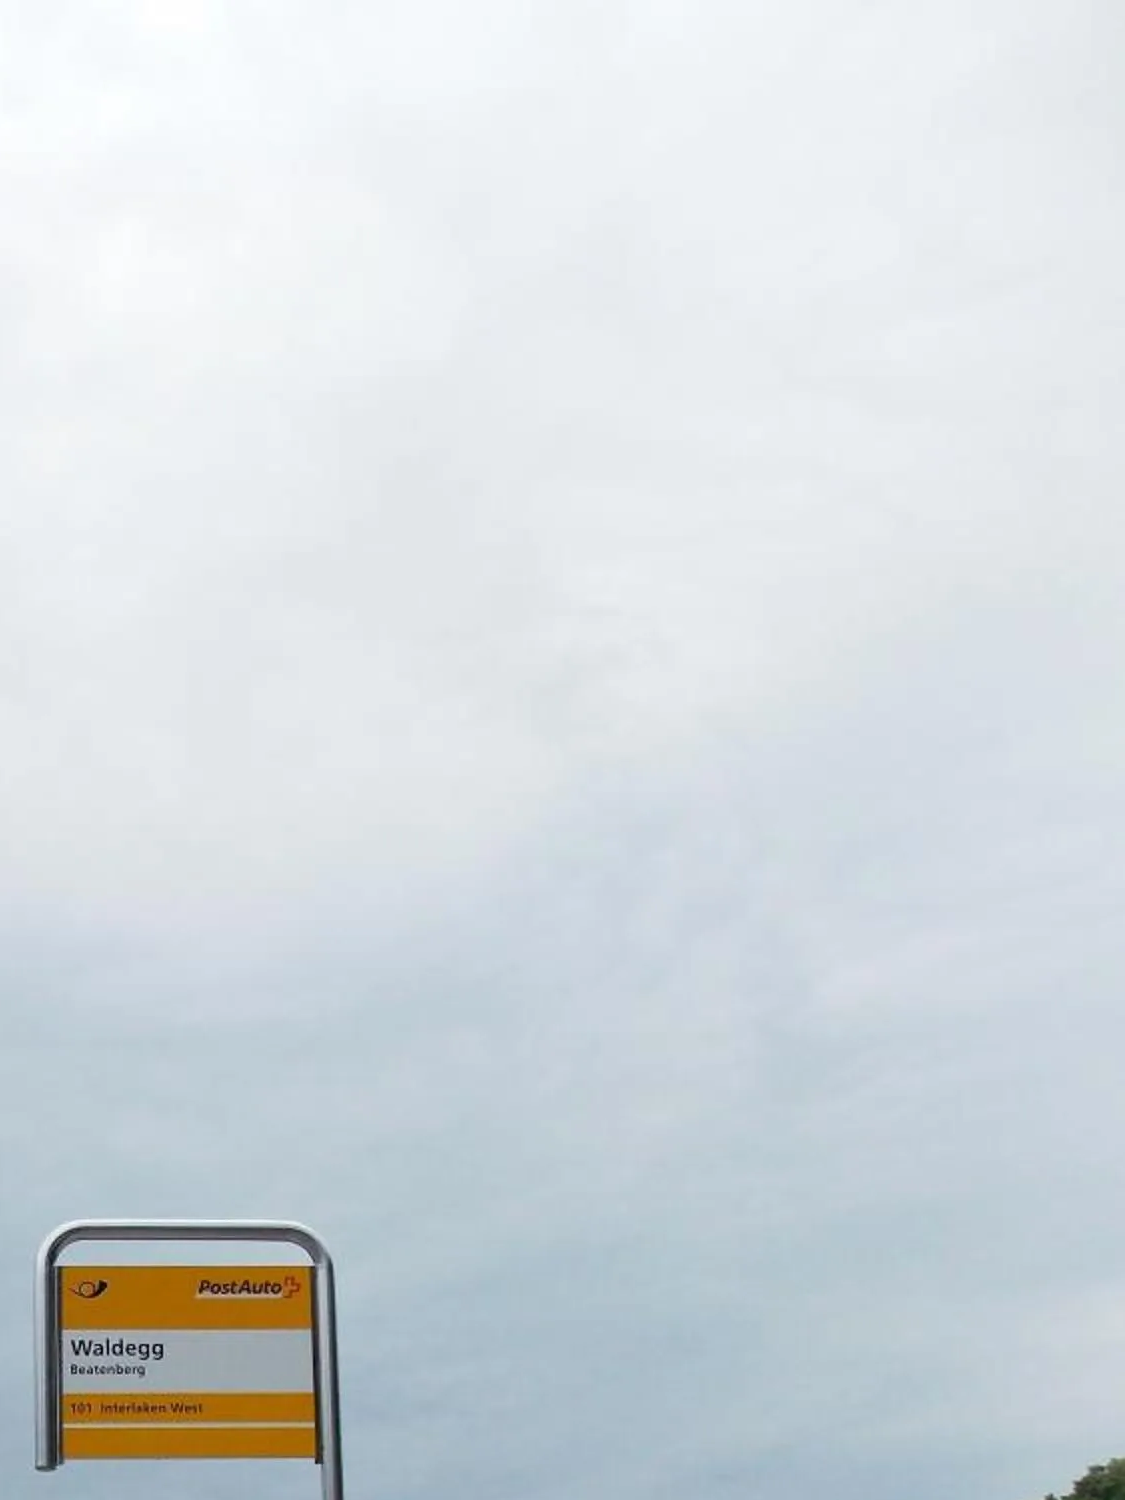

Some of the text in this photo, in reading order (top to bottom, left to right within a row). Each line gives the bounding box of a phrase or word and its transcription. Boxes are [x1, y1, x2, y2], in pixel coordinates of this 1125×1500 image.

[198, 1279, 283, 1295] PostAuto
[70, 1337, 164, 1361] Waldegg
[70, 1363, 146, 1378] Beatenberg
[70, 1402, 203, 1414] 101 Interlaken West
